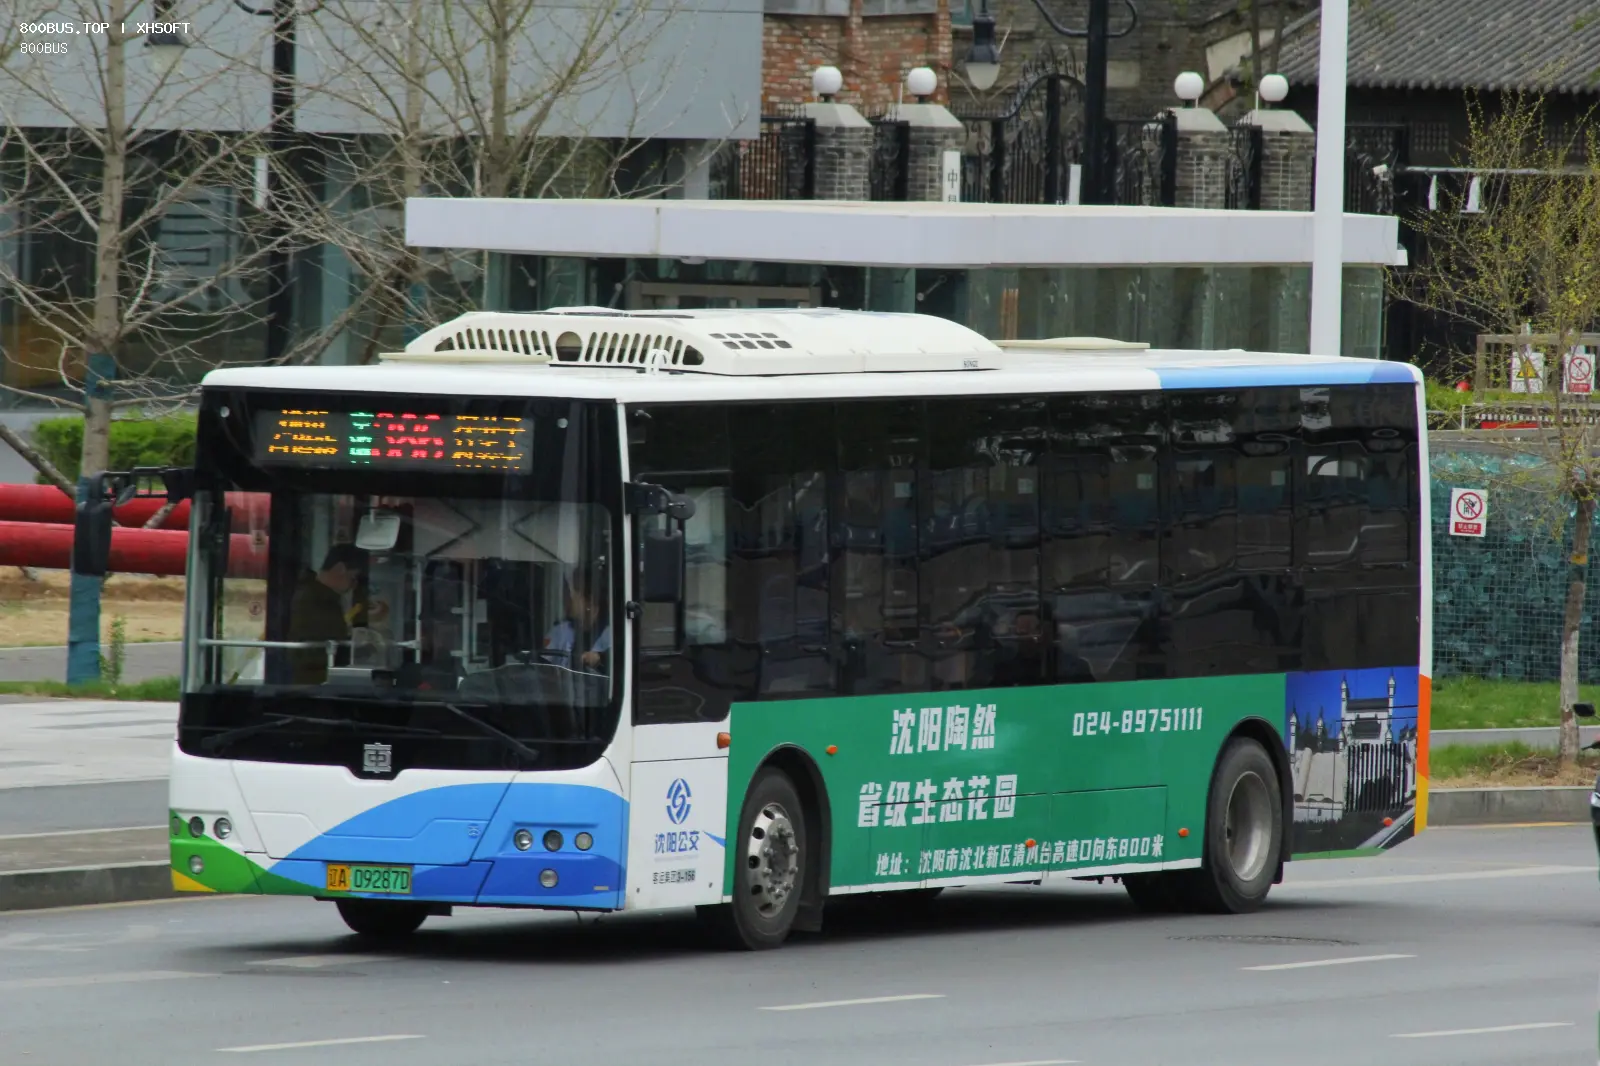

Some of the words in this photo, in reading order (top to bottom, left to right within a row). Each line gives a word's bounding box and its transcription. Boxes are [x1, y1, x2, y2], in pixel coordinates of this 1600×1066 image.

[889, 703, 998, 755] 沈阳陶然
[1072, 706, 1204, 737] 024-89751111
[857, 773, 1019, 828] 省级生态花园
[654, 830, 700, 854] 沈阳公交
[354, 869, 411, 891] 09287D
